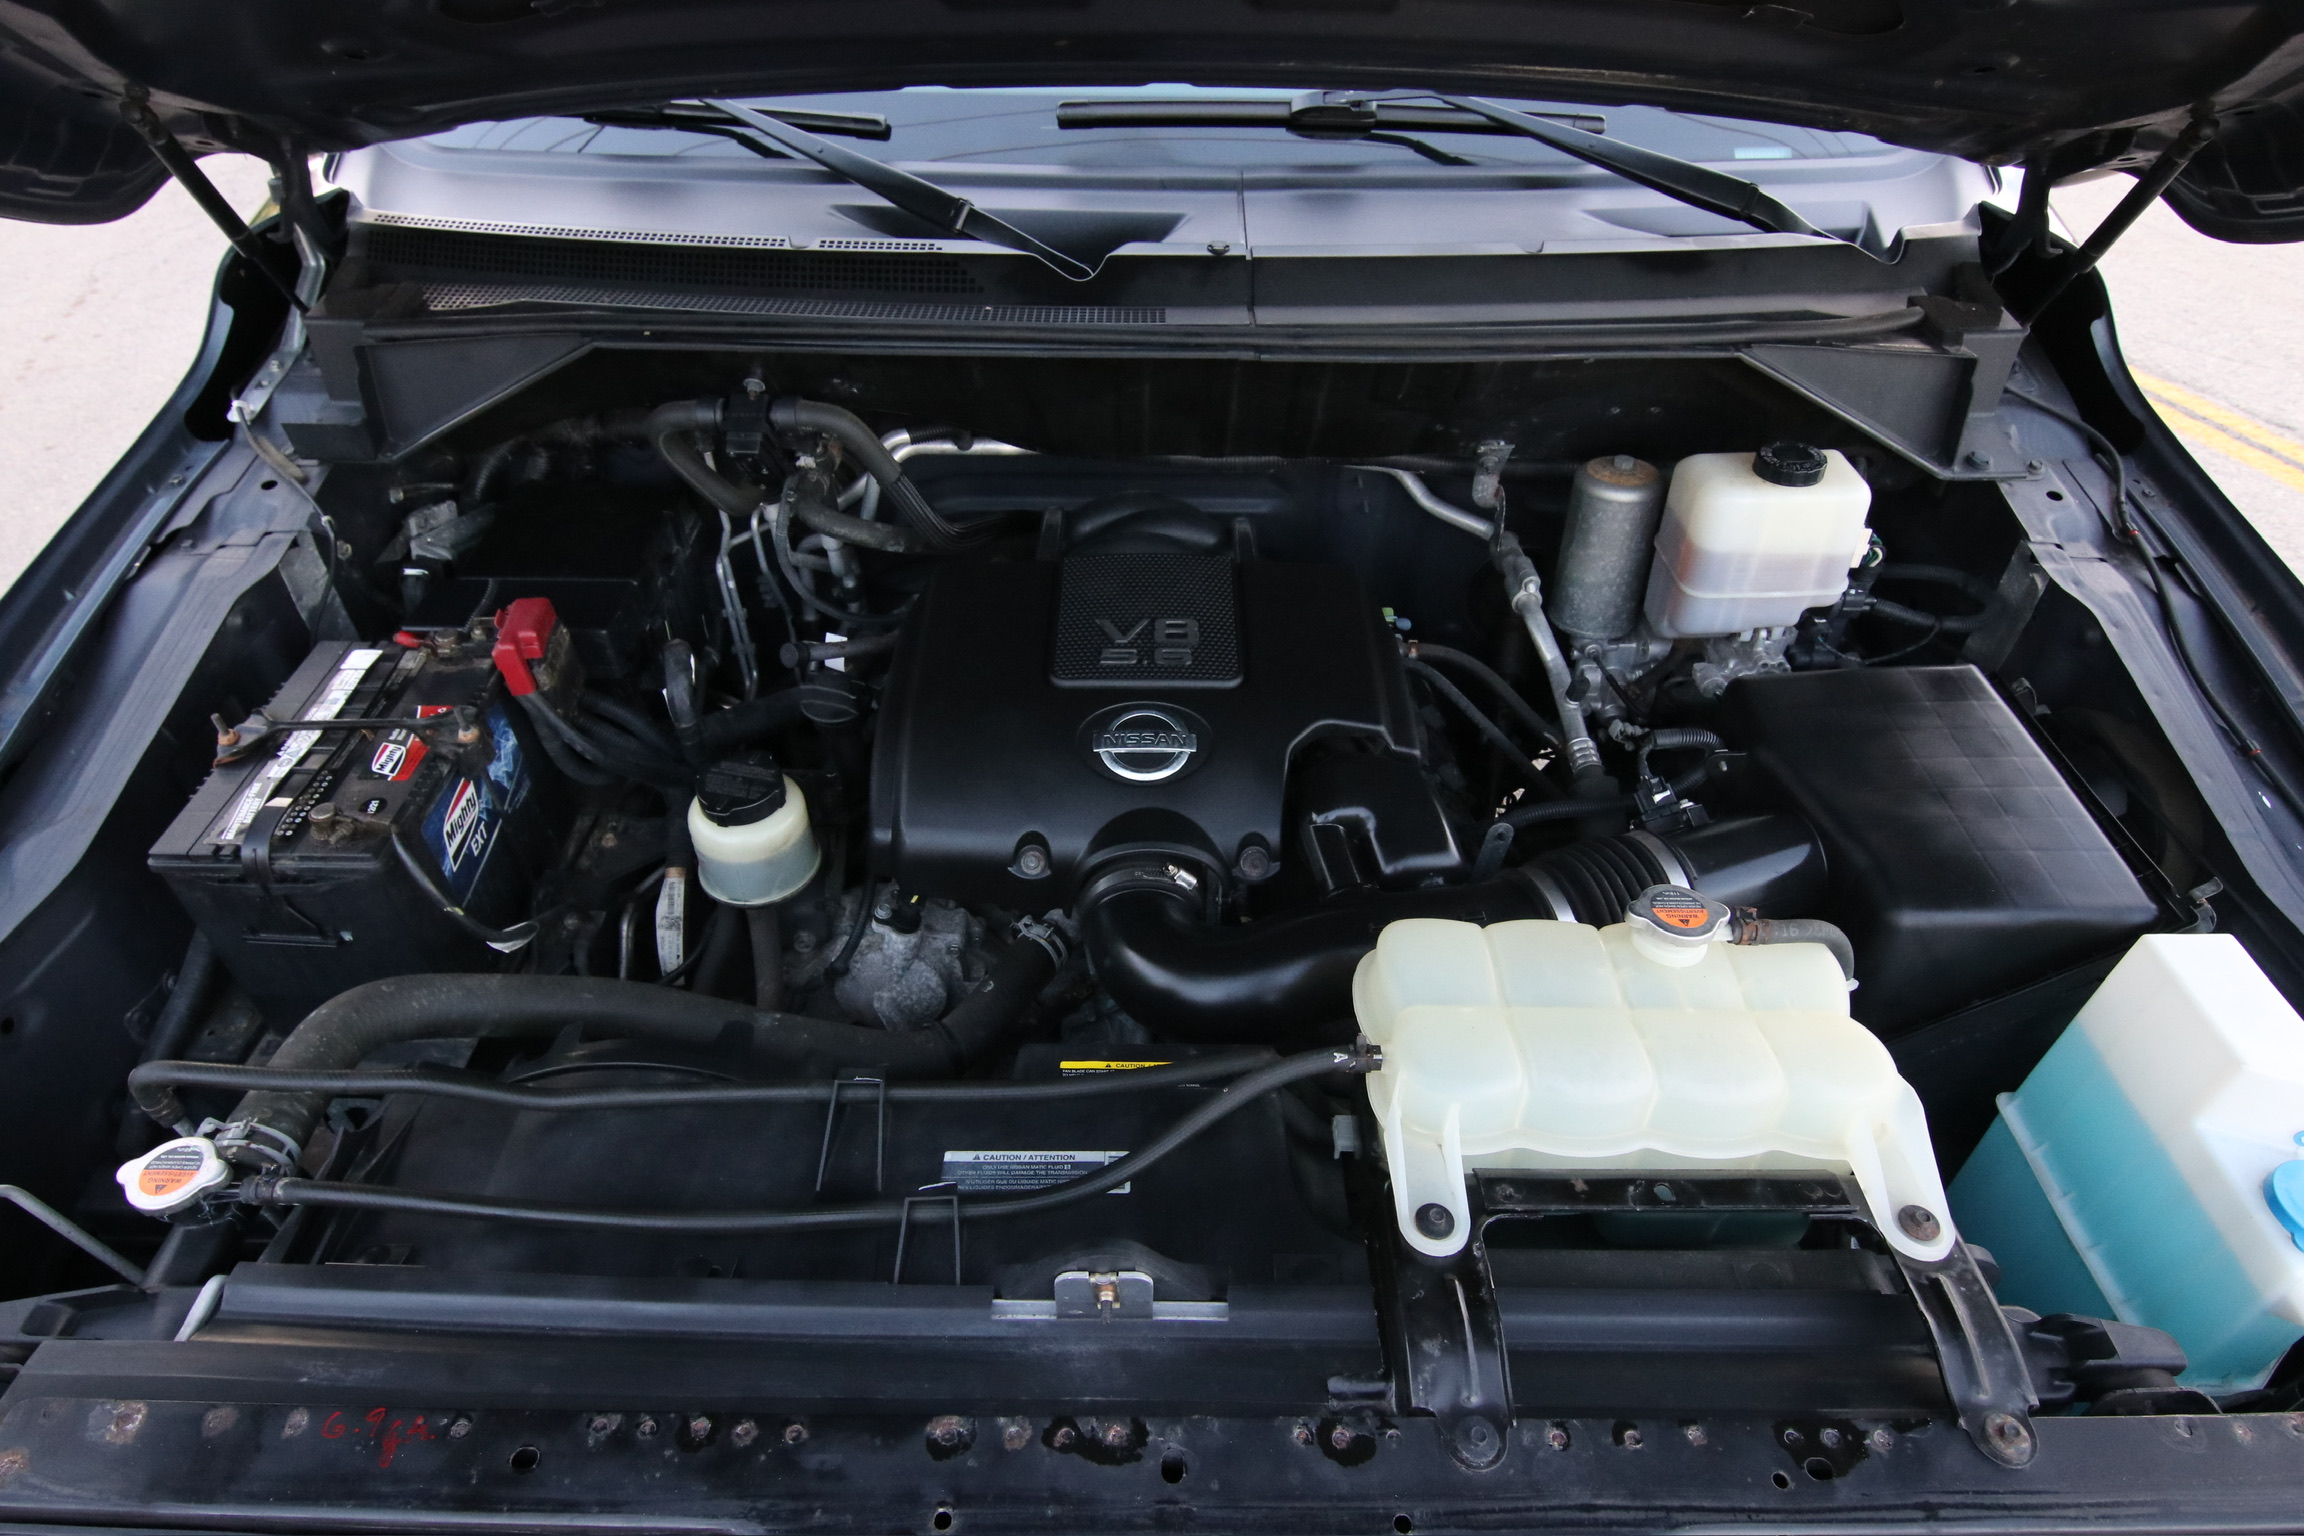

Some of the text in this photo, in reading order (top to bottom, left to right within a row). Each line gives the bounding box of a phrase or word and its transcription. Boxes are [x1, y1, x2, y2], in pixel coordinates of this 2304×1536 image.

[1094, 618, 1200, 646] V8
[1099, 647, 1193, 665] 5.6
[1103, 732, 1188, 746] NISSAN
[375, 745, 403, 773] Mighty
[444, 791, 477, 849] Mighty
[470, 820, 488, 857] EXT
